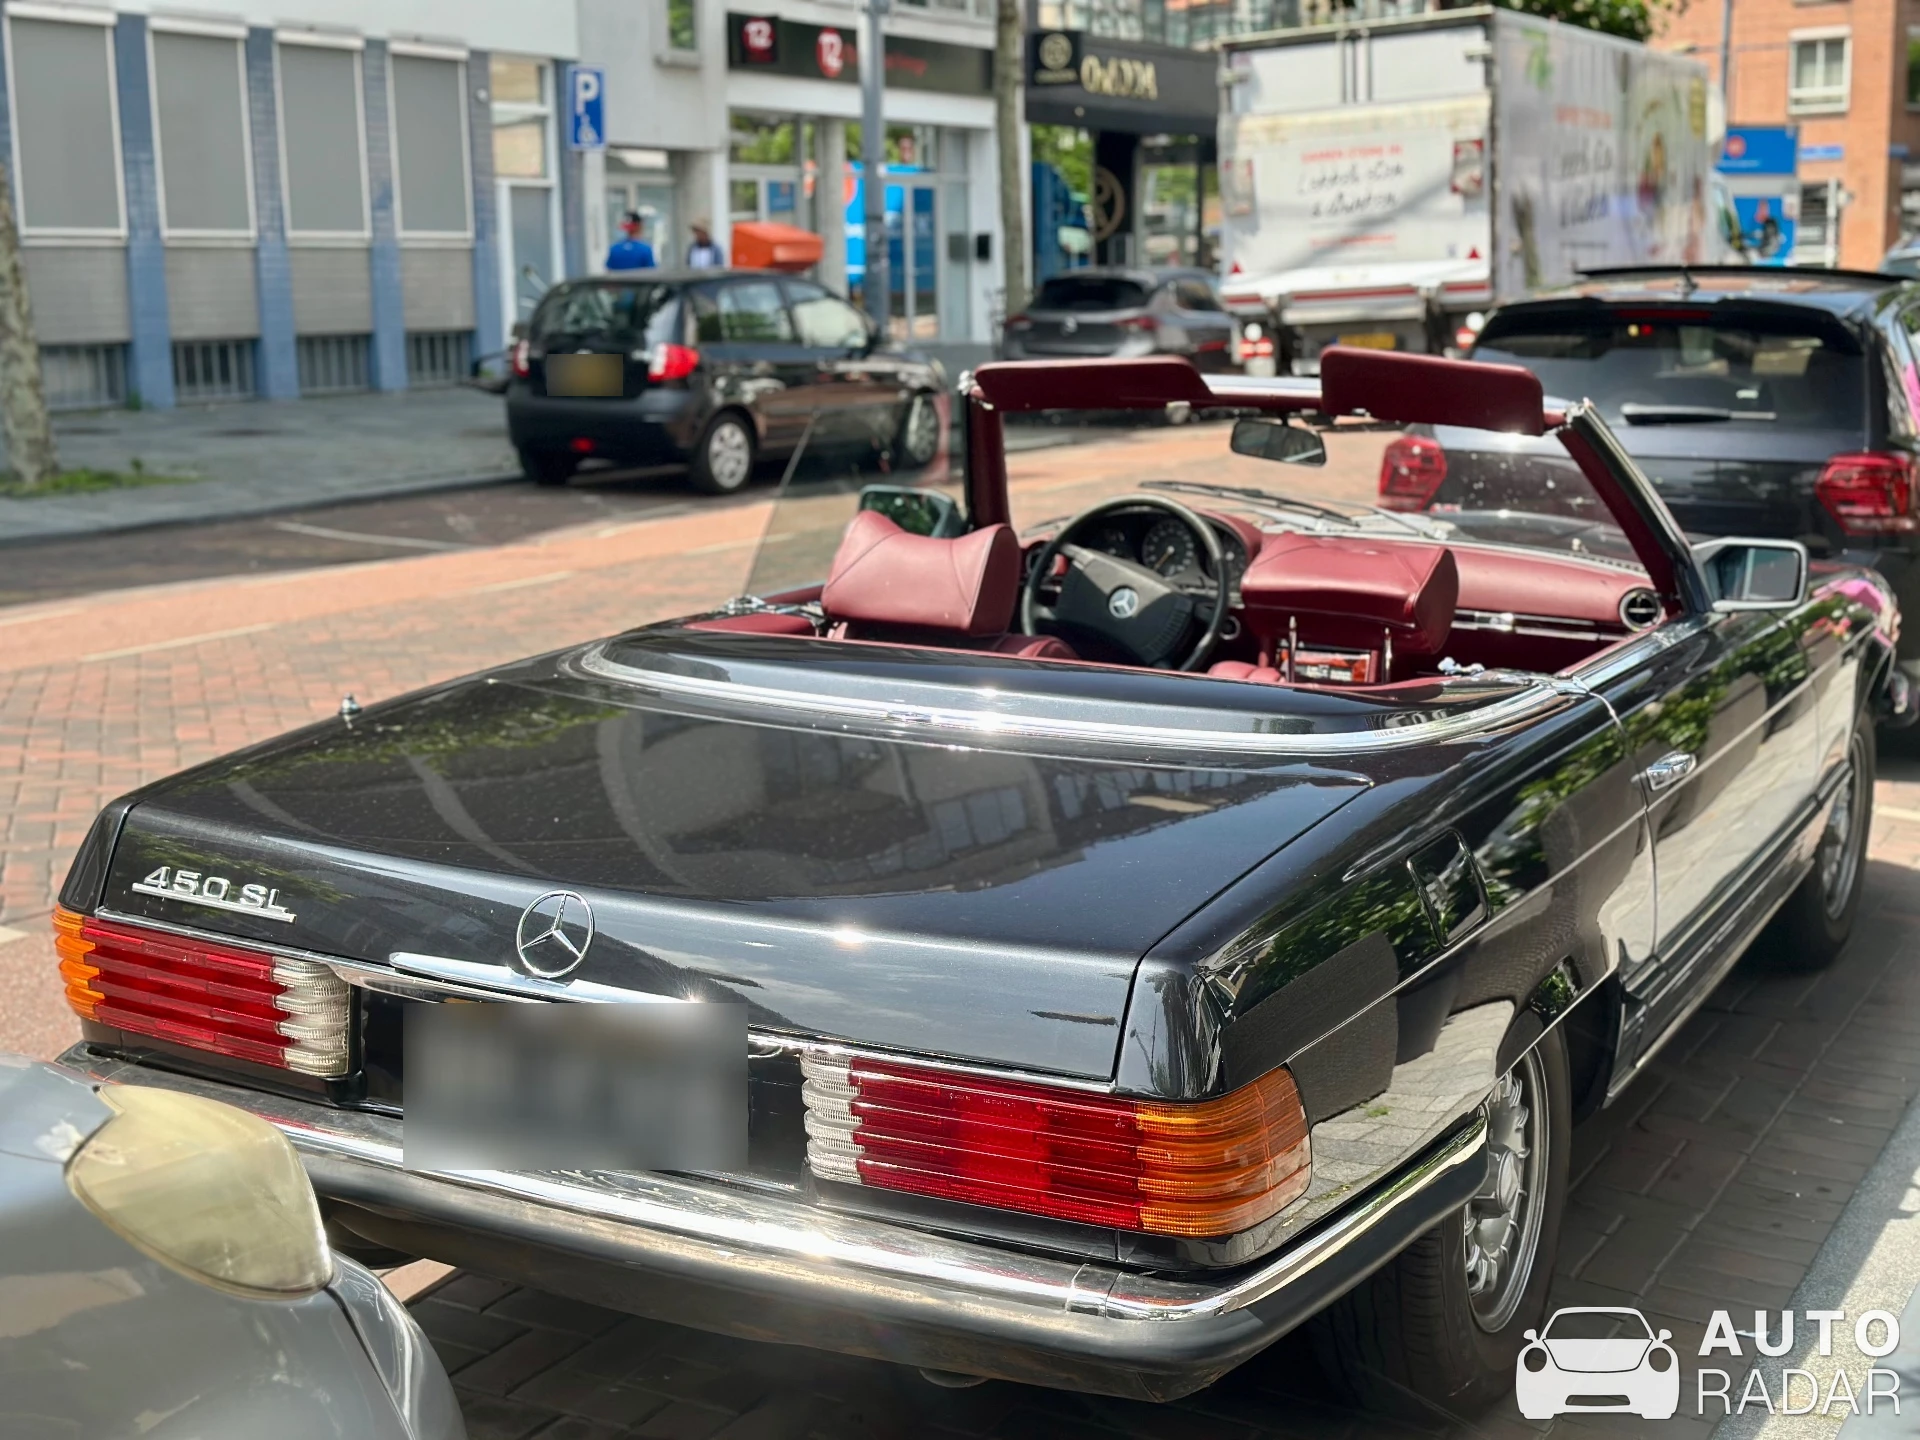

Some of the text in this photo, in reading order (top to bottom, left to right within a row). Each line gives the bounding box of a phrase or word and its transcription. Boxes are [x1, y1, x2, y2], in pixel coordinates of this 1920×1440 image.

[575, 72, 600, 116] P
[143, 866, 289, 914] 450 SL
